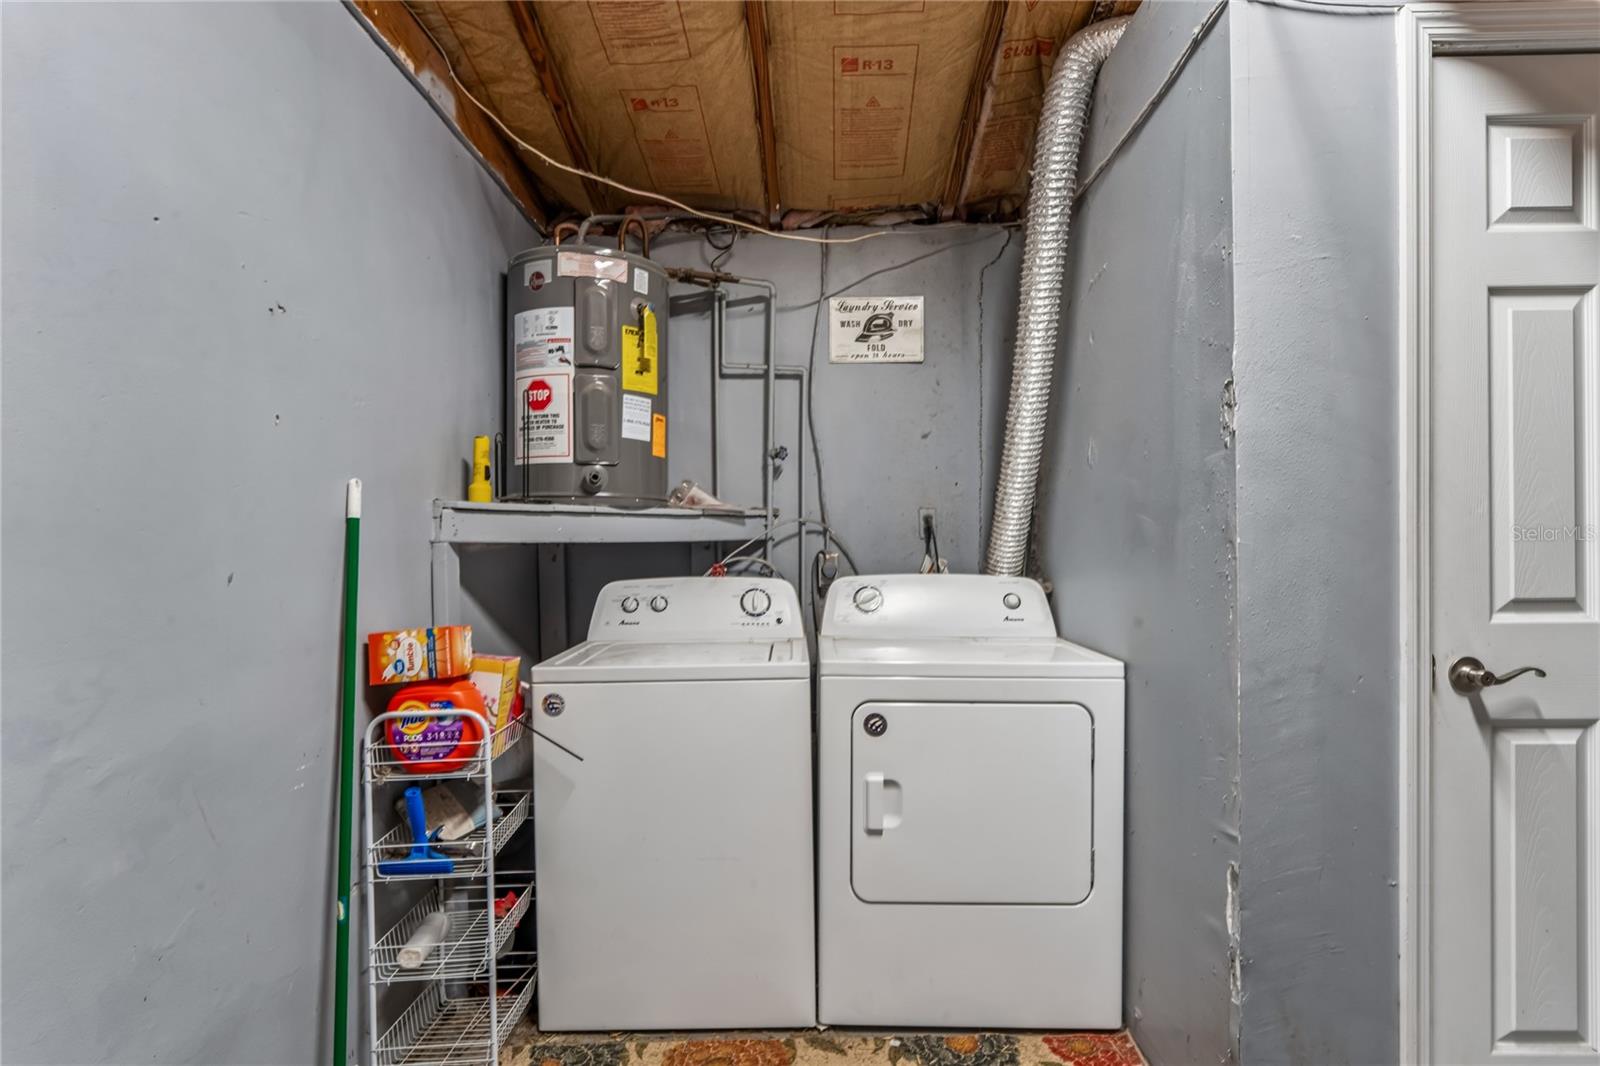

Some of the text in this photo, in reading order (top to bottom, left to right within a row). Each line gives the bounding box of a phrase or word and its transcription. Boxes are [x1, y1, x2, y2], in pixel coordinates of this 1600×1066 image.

[863, 59, 894, 70] R-13
[836, 299, 919, 313] Laundry Service
[840, 320, 861, 328] WASH
[898, 319, 913, 327] DRY
[867, 344, 886, 352] FOLD
[882, 350, 905, 358] hours
[528, 389, 550, 402] STOP
